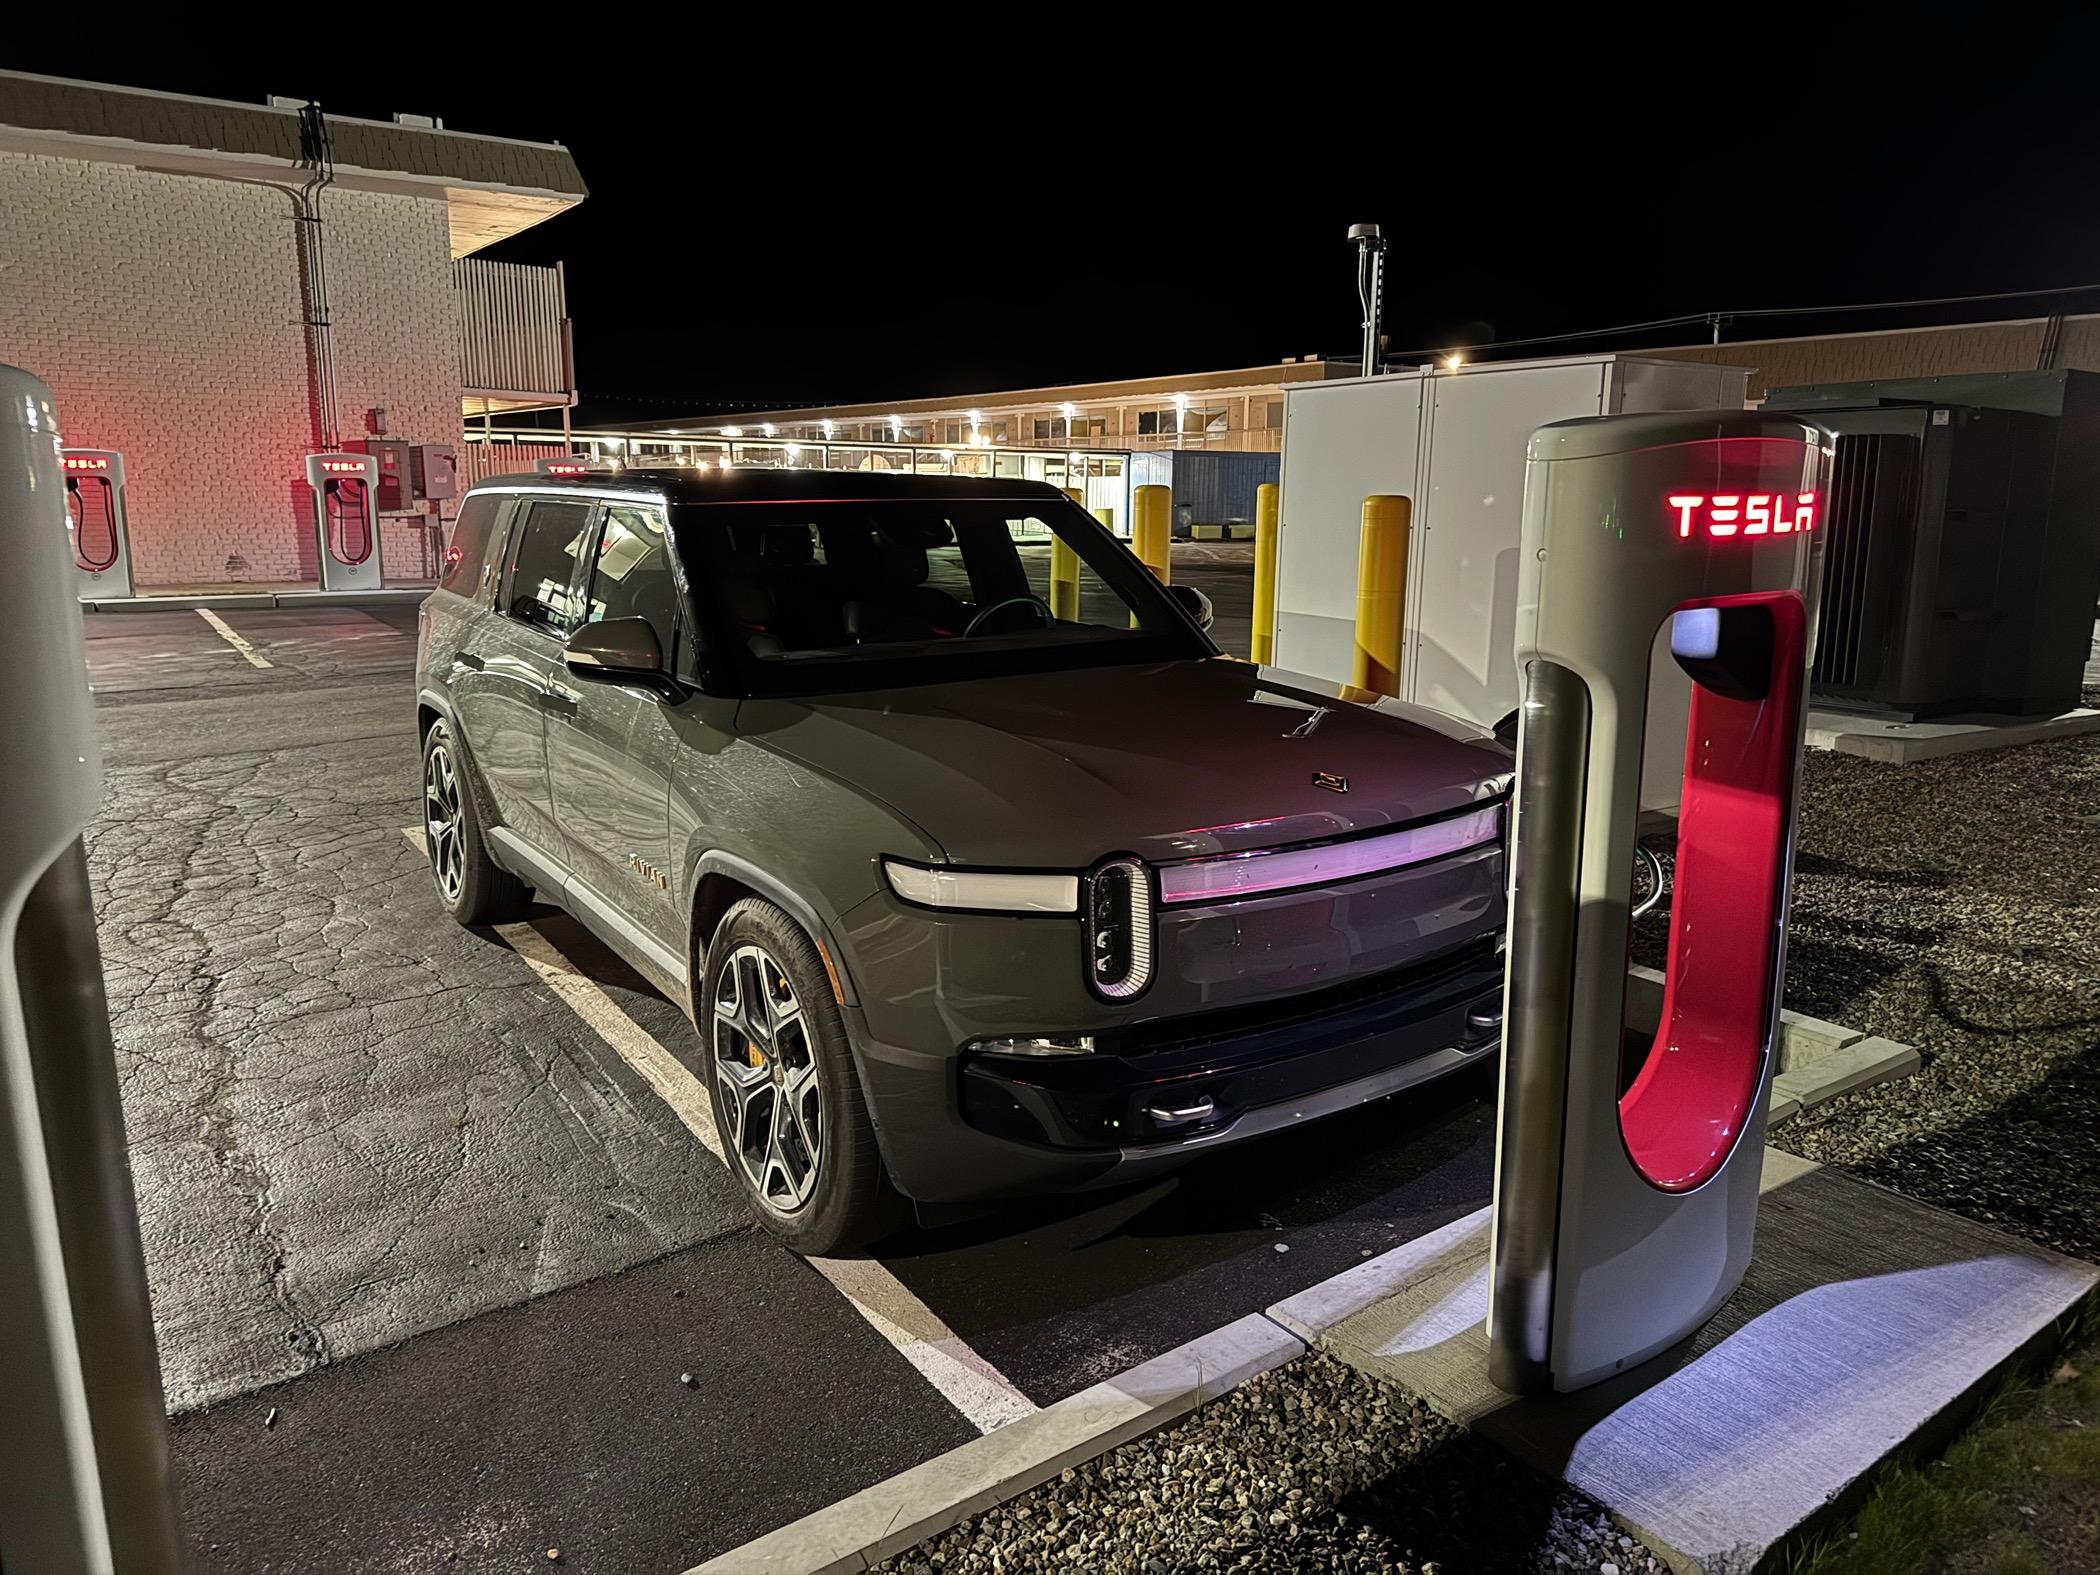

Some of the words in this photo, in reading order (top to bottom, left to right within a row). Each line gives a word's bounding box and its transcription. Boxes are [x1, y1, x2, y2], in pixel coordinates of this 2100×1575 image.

[322, 462, 365, 471] TESLA
[1668, 493, 1815, 537] TESLA
[629, 853, 667, 889] RIVIAN
